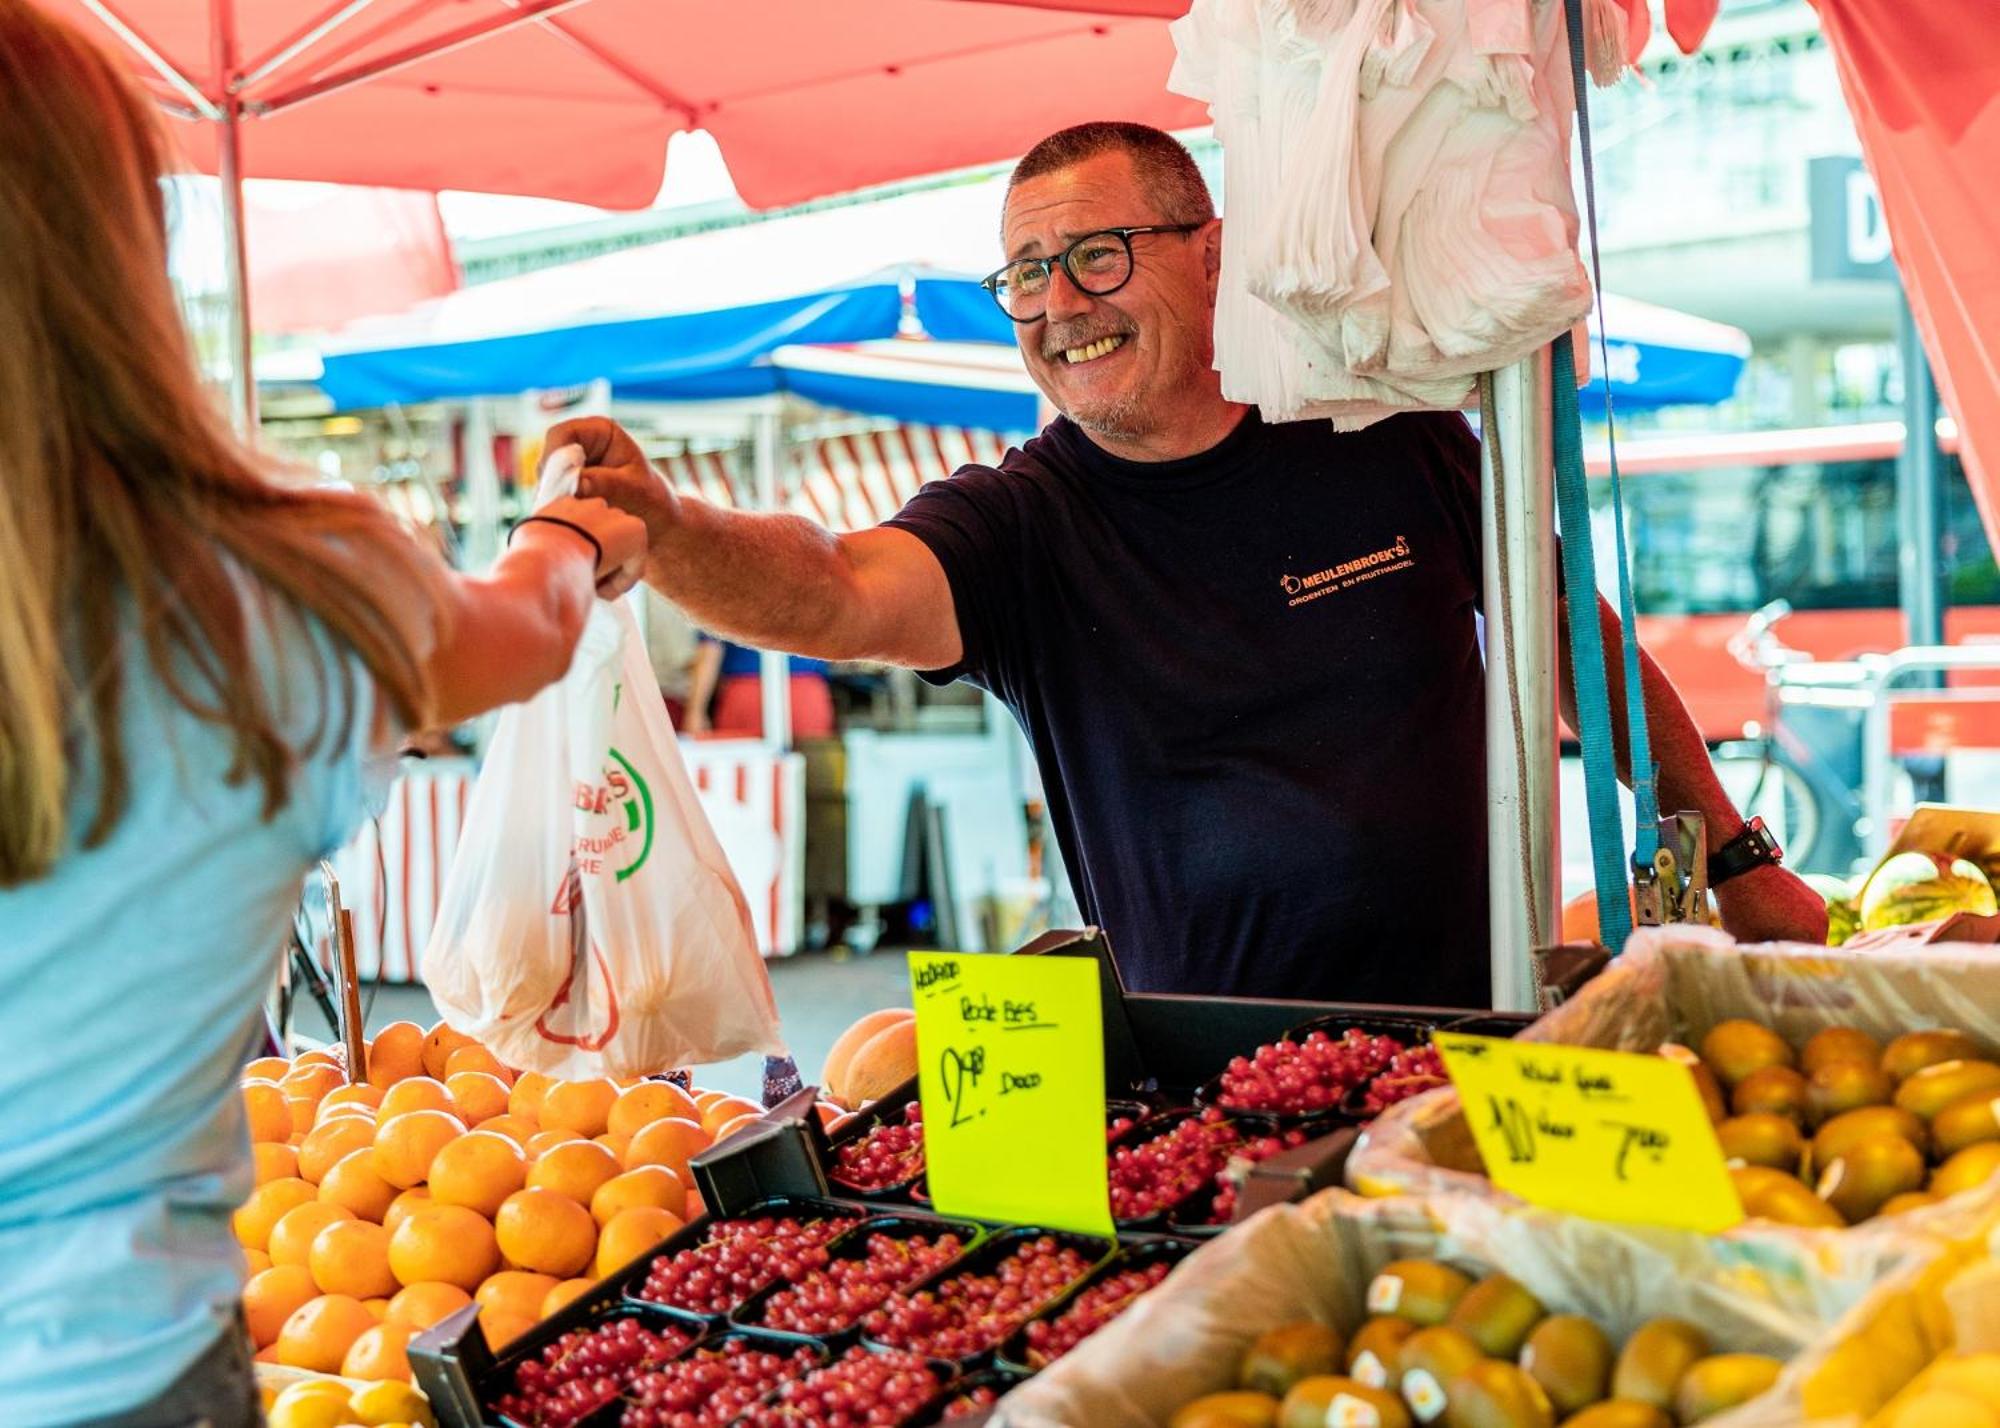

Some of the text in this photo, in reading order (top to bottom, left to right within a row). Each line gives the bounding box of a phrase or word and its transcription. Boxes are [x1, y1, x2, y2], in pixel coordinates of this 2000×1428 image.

[1288, 584, 1339, 606] GROENTEN
[1356, 559, 1415, 583] FRUITHANDEL
[1302, 544, 1405, 588] MEULENBROEK'S
